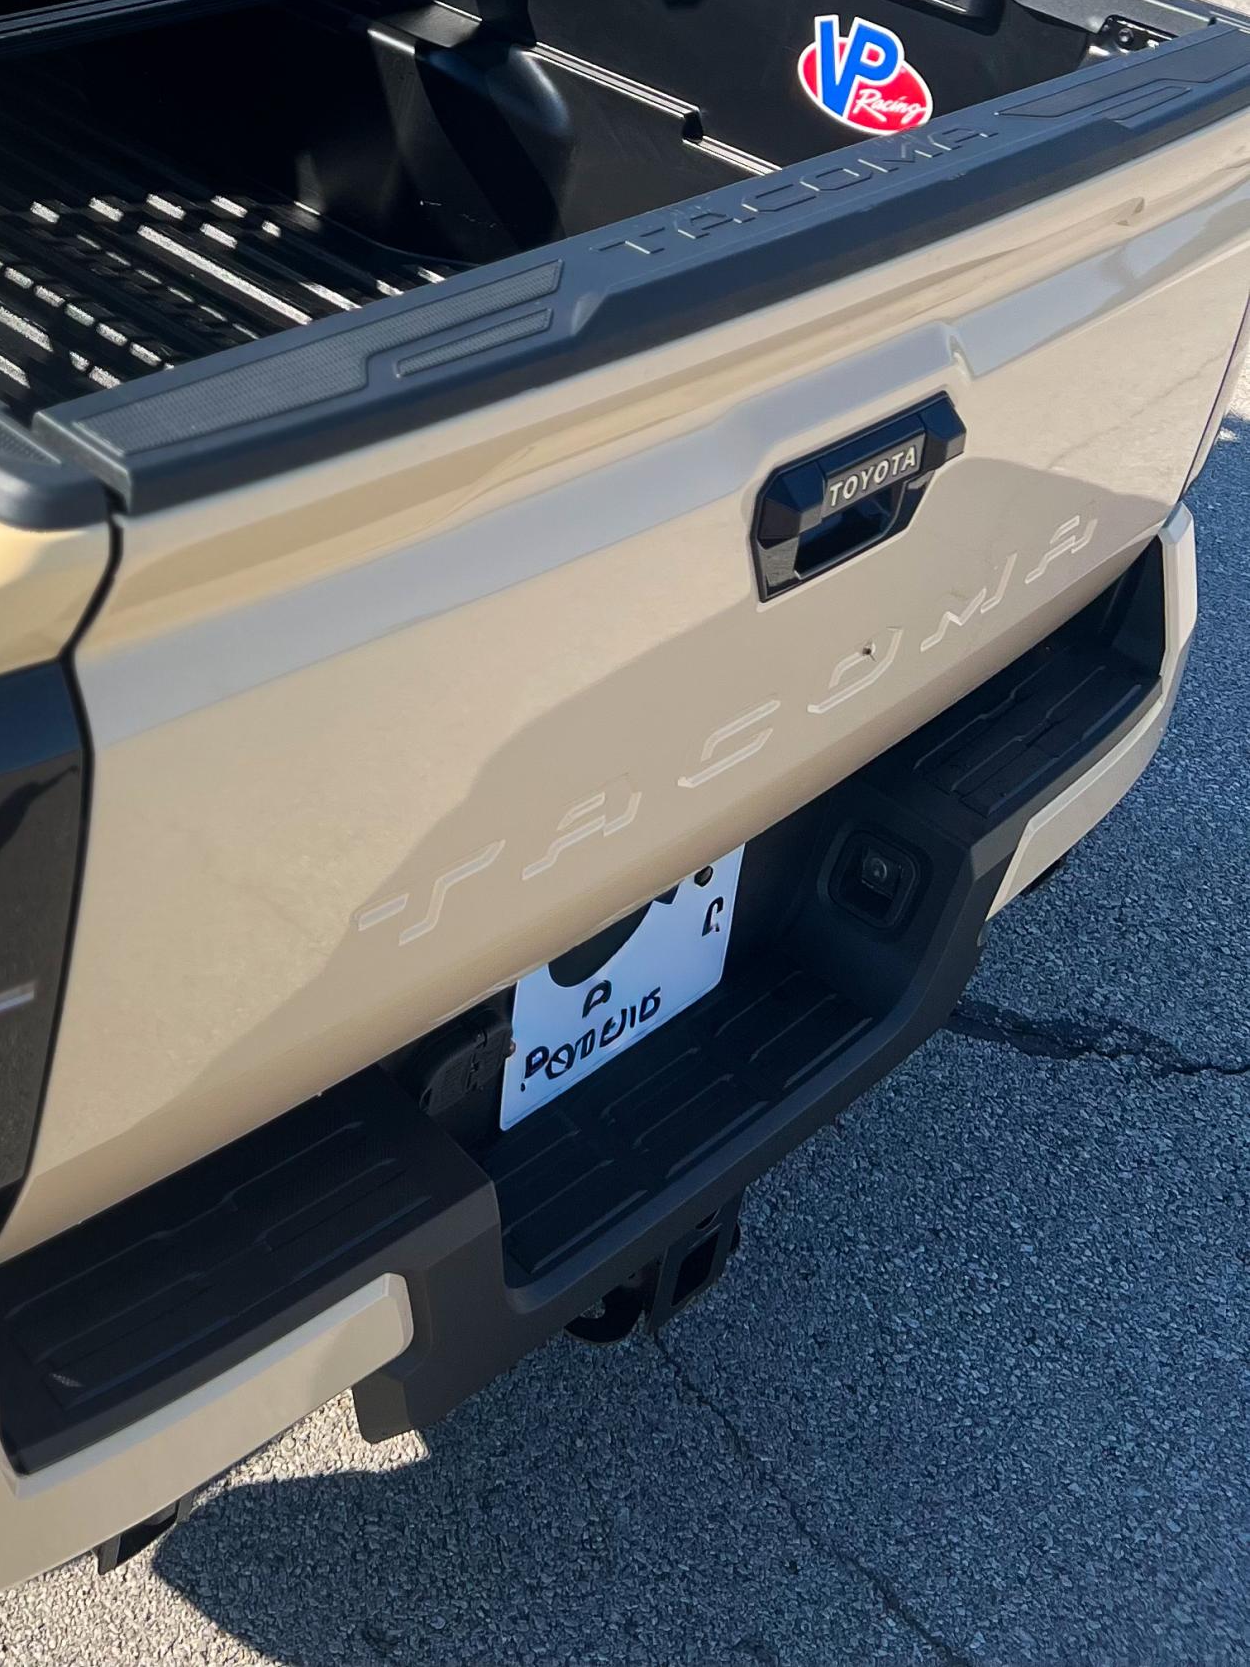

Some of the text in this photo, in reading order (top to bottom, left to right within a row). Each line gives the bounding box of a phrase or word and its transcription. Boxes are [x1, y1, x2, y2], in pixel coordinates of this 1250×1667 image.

[815, 15, 904, 119] VP
[853, 89, 929, 122] Racing
[590, 127, 999, 254] TACOMA
[829, 446, 917, 507] TOYOTA
[356, 514, 1097, 945] TACOMA
